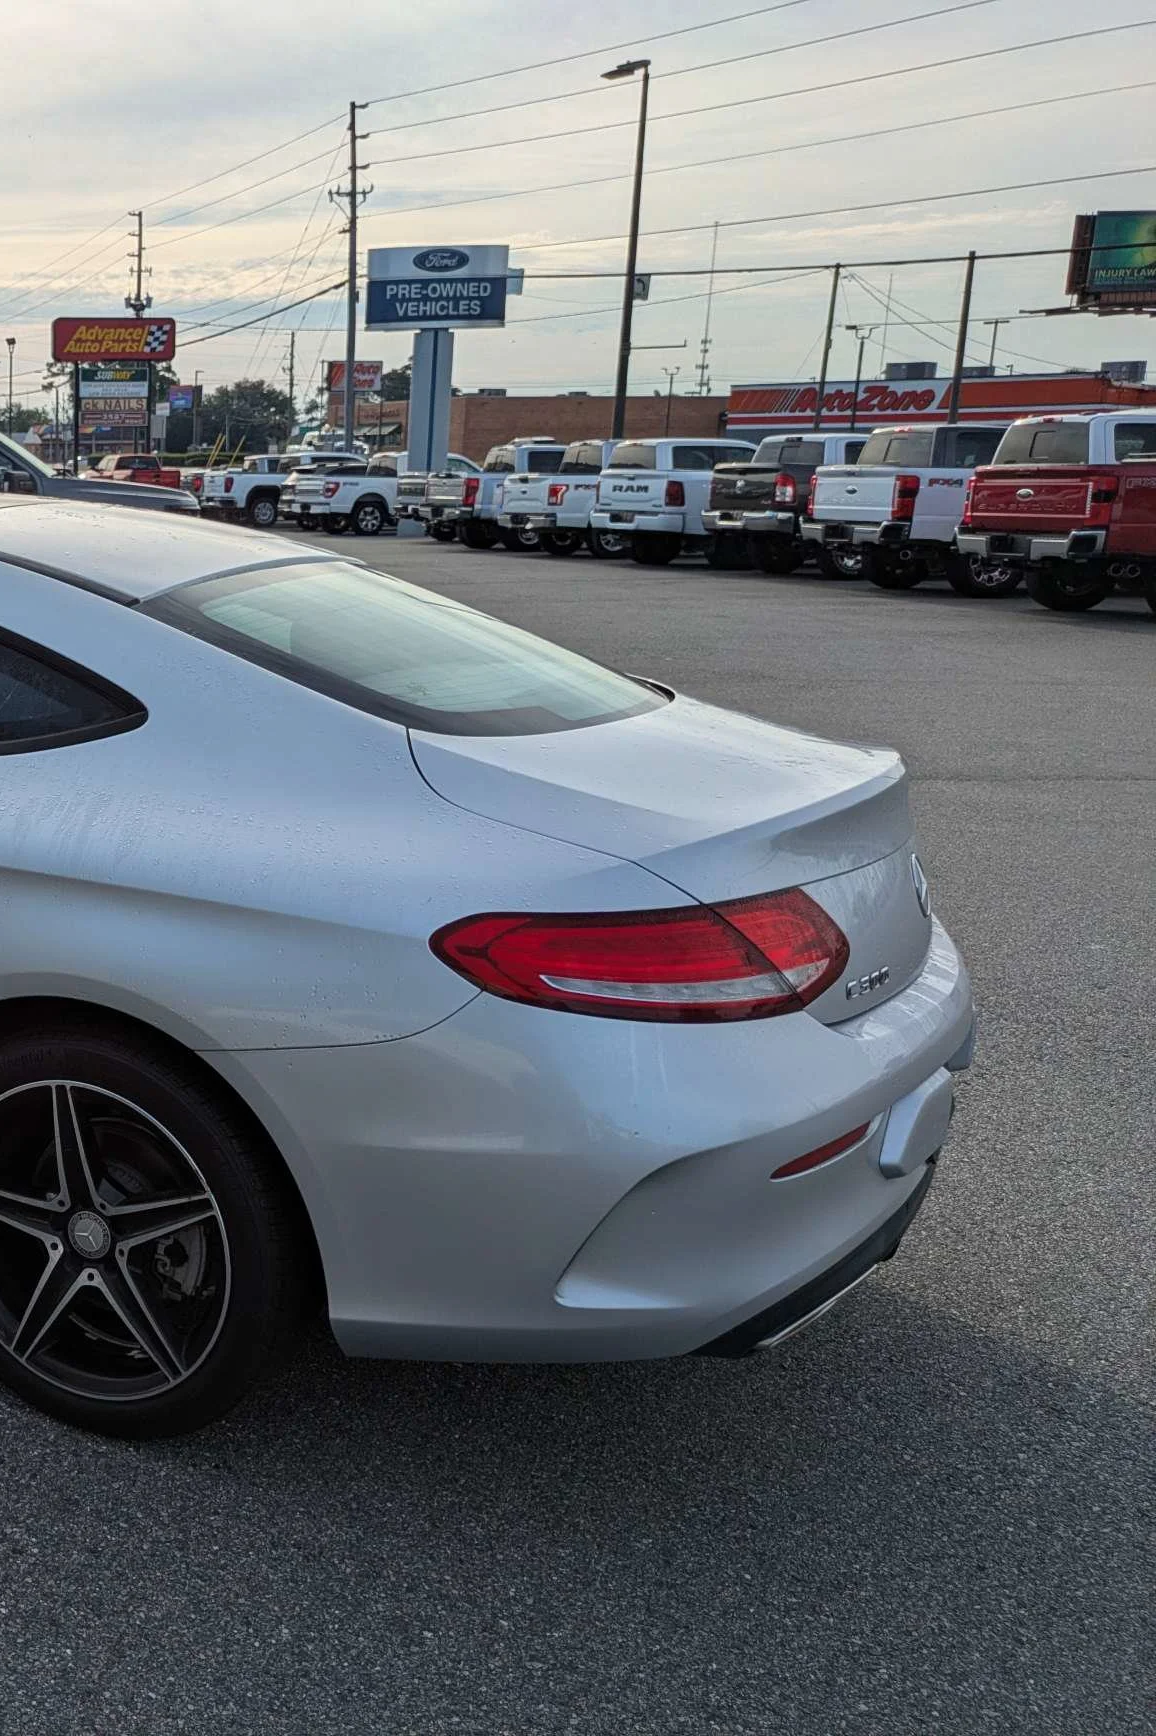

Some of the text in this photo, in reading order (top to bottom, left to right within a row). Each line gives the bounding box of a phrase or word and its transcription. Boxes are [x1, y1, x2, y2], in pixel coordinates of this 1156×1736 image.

[424, 252, 459, 269] Ford
[1095, 269, 1131, 279] INJURY
[386, 282, 491, 299] PRE-OWNED
[396, 300, 481, 317] VEHICLES
[73, 325, 142, 341] Advance
[63, 340, 138, 353] Auto Parts
[94, 370, 133, 381] SUBWAY
[104, 399, 144, 411] NAILS
[789, 385, 936, 413] AutoZone
[612, 484, 650, 493] RAM
[928, 477, 963, 488] FX4
